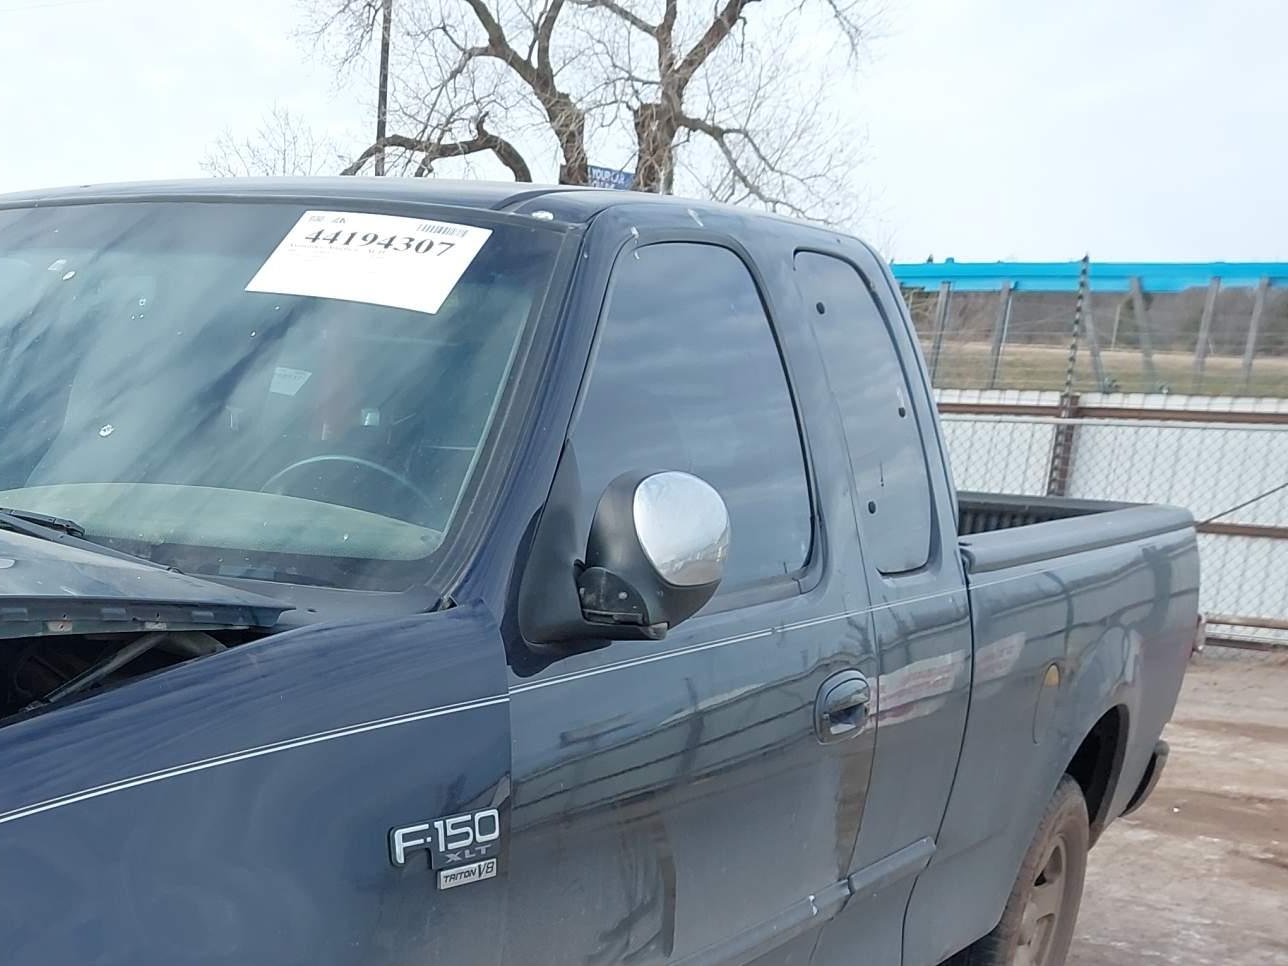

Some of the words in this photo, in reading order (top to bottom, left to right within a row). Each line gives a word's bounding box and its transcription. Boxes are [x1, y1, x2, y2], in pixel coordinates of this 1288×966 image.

[304, 229, 455, 256] 44194307
[394, 808, 500, 864] F-150
[445, 844, 492, 864] XLT
[443, 869, 476, 883] TRITON
[477, 861, 495, 879] V8
